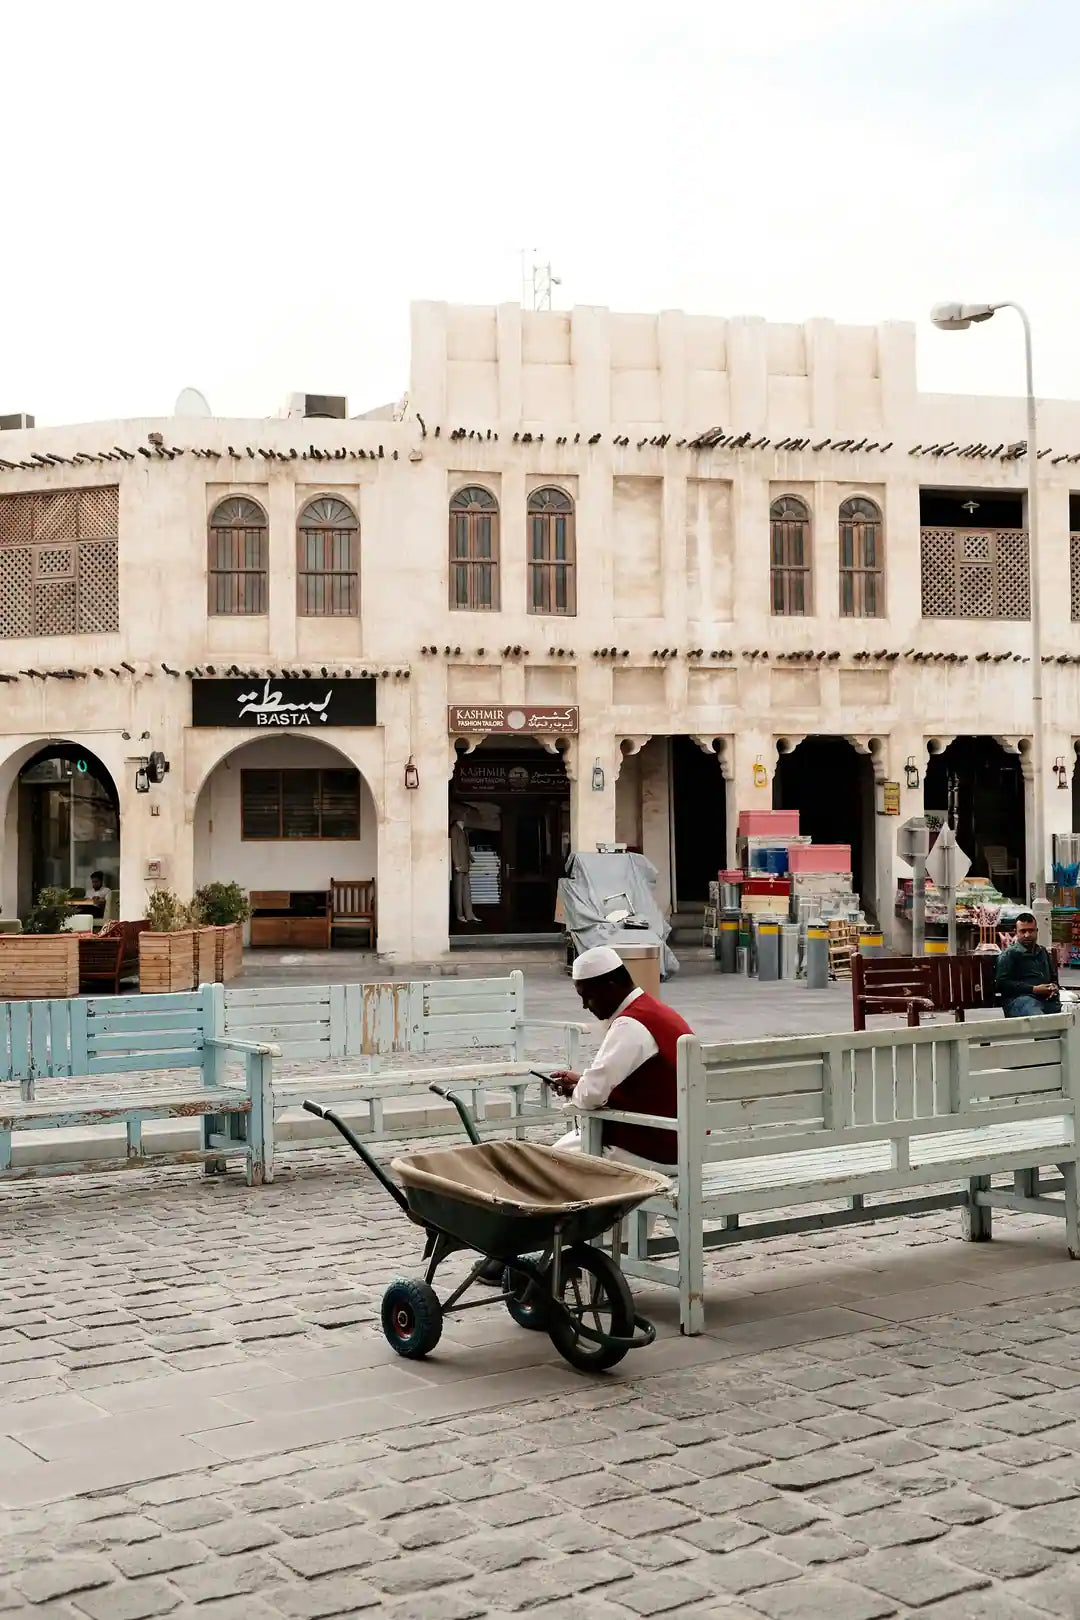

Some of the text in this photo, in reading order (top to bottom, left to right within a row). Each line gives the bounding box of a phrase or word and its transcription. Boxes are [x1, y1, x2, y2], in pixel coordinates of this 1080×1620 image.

[237, 679, 332, 722] بسطة
[257, 714, 310, 724] BASTA
[457, 710, 504, 719] KASHMIR
[528, 708, 573, 721] كشمير
[460, 767, 506, 776] KASHMIR
